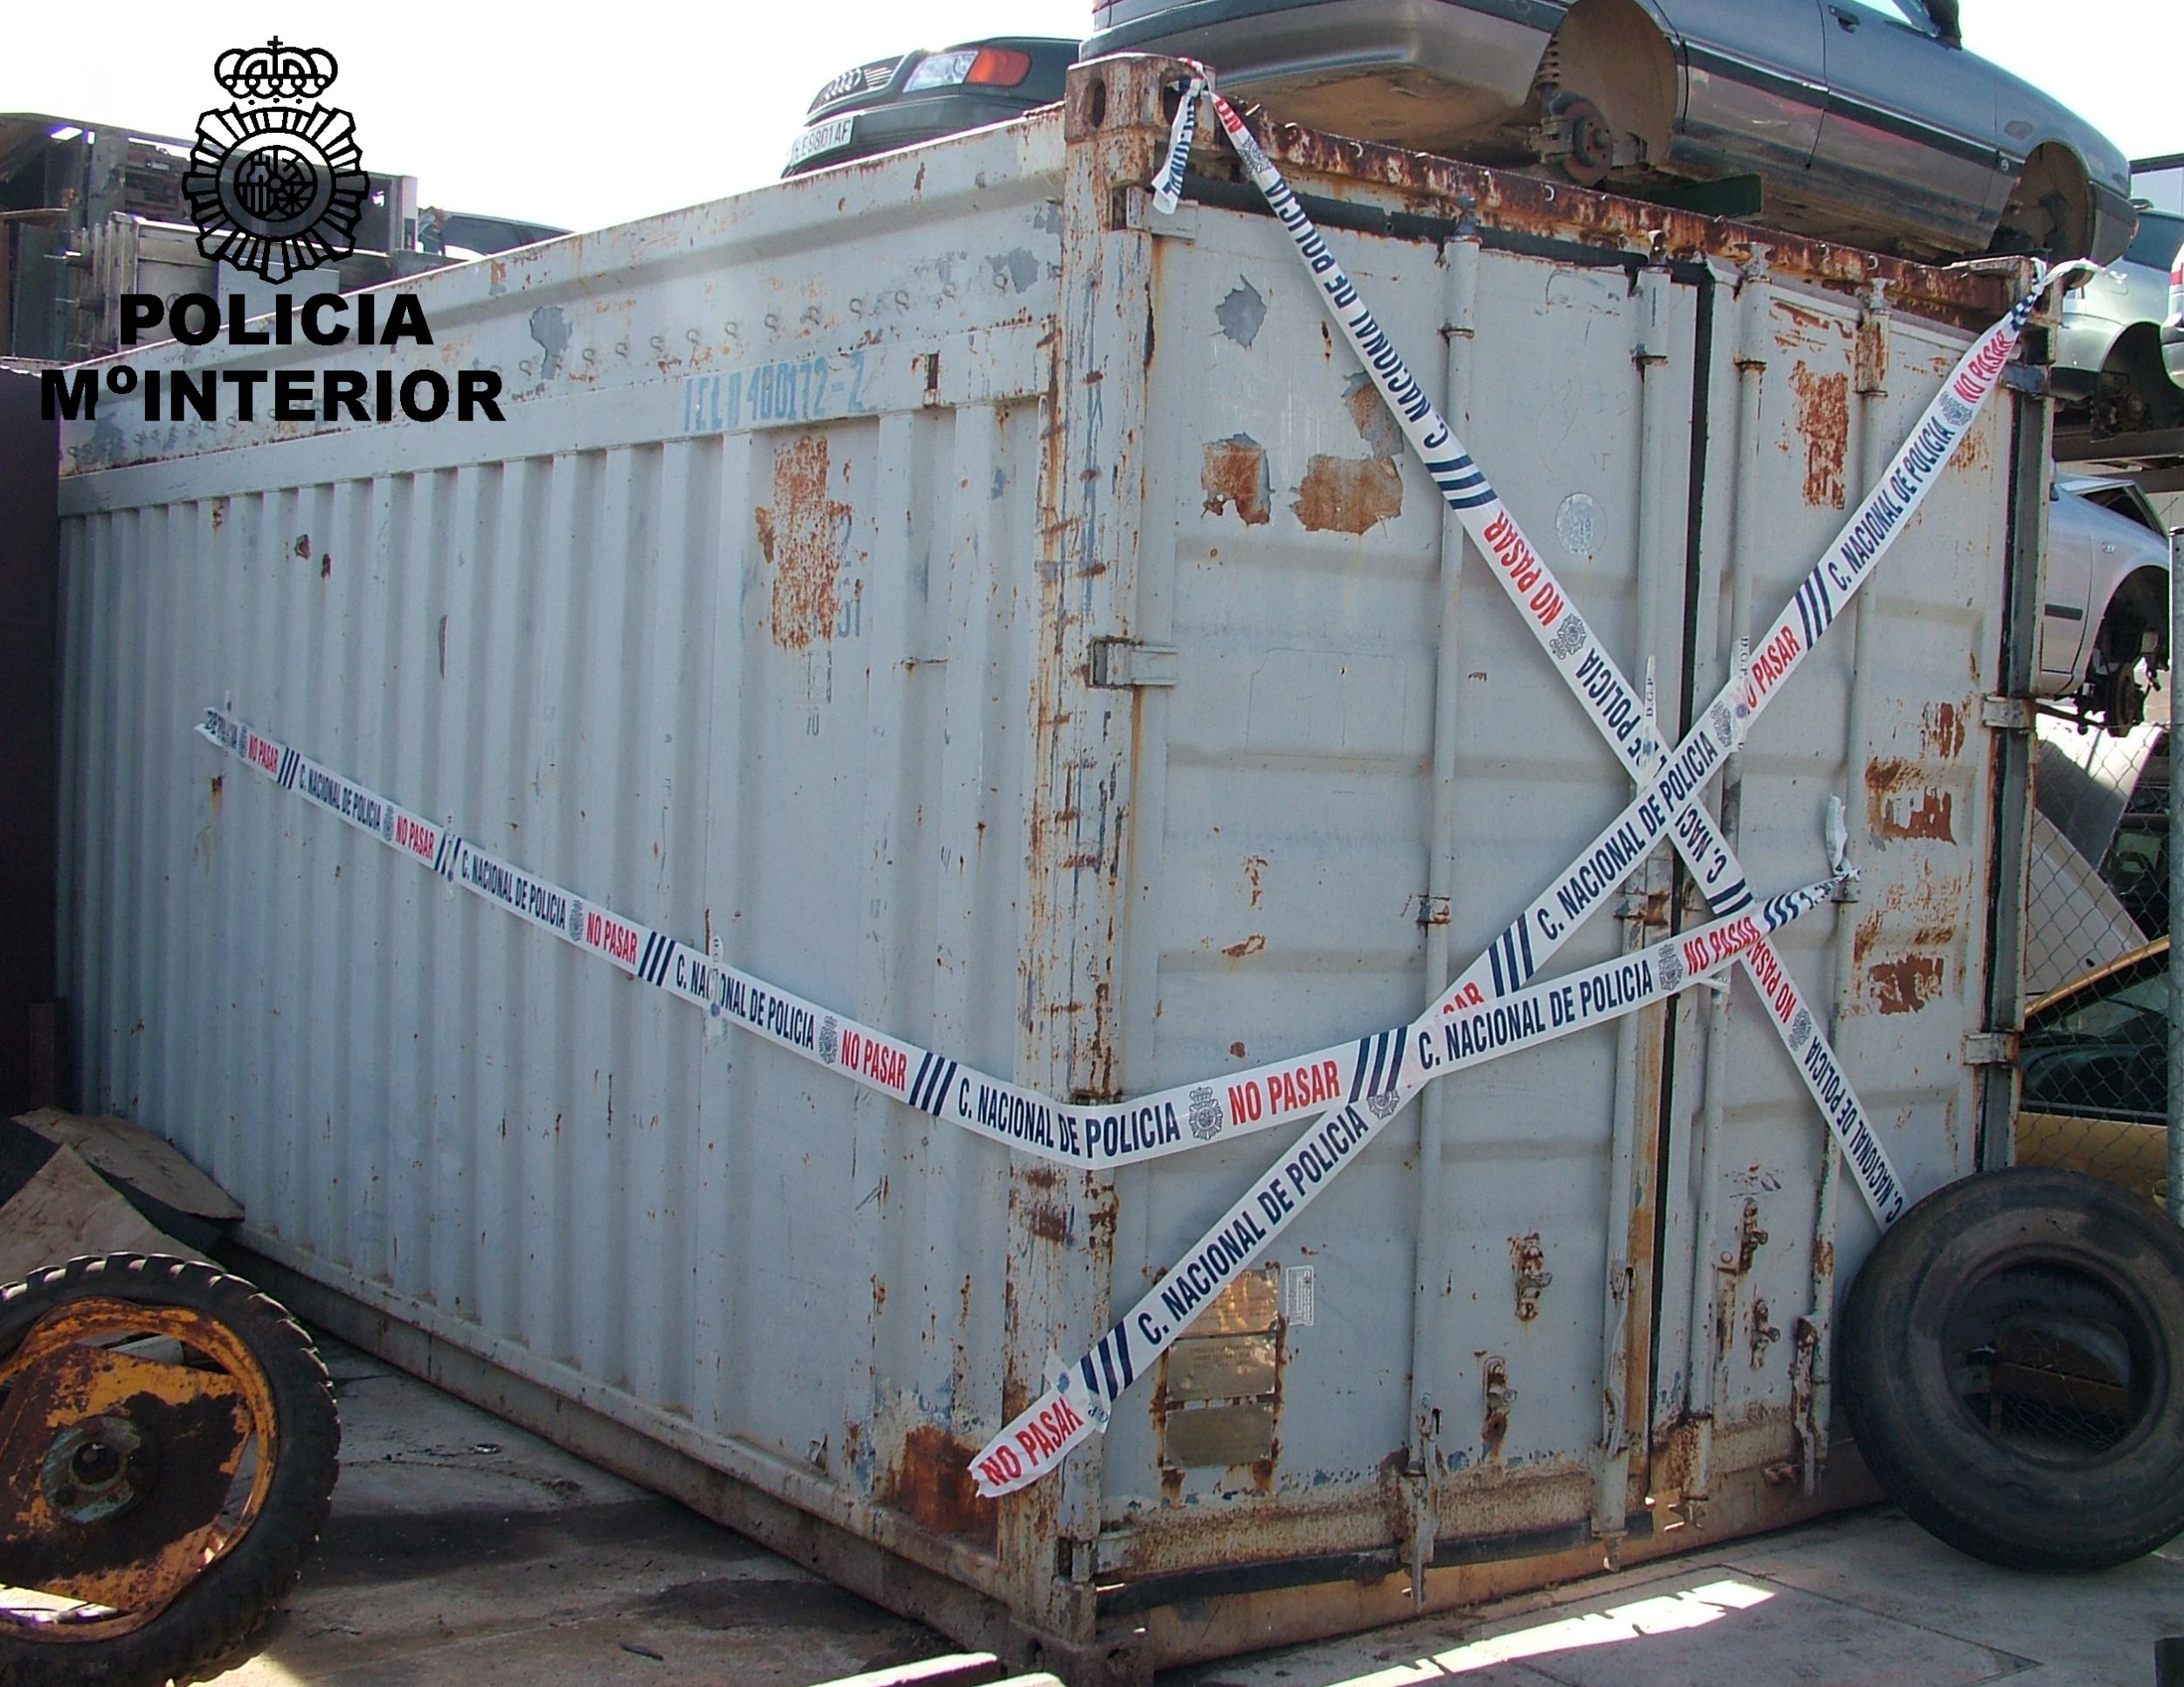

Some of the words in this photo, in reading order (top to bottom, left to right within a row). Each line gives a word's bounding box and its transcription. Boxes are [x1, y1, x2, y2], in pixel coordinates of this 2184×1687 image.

[1967, 329, 2015, 382] PASAR
[1952, 372, 1986, 404] NO
[1902, 415, 1956, 483] POLICIA
[1890, 467, 1918, 504] DE
[1483, 510, 1542, 593] PASAR
[1840, 488, 1904, 575] NACIONAL
[1530, 582, 1565, 626] NO
[1828, 562, 1852, 591] C.
[1751, 626, 1800, 695] PASAR
[1575, 647, 1641, 743] POLICIA
[395, 815, 408, 847] NO
[408, 821, 435, 861] PASAR
[1537, 908, 1565, 941] C.
[1556, 820, 1647, 921] NACIONAL
[1638, 793, 1667, 838] DE
[1658, 730, 1718, 813] POLICIA
[1706, 847, 1727, 884] C.
[461, 849, 470, 881] C.
[471, 854, 513, 903] NACIONAL
[515, 877, 528, 910] DE
[528, 883, 566, 930] POLICIA
[586, 911, 602, 947] NO
[603, 920, 638, 965] PASAR
[1683, 936, 1710, 977] NO
[1709, 916, 1764, 964] PASAR
[1745, 940, 1782, 998] PASA
[676, 953, 686, 989] C.
[749, 988, 766, 1027] DE
[767, 996, 814, 1051] POLICIA
[1418, 1031, 1441, 1070] C.
[1444, 997, 1546, 1062] NACIONAL
[1549, 985, 1576, 1027] DE
[1579, 959, 1654, 1018] POLICIA
[1774, 982, 1797, 1024] NO
[840, 1029, 860, 1071] NO
[862, 1039, 907, 1092] PASAR
[1804, 1035, 1847, 1115] POLICIA
[958, 1077, 972, 1119] C.
[977, 1084, 1054, 1149] NACIONAL
[1057, 1113, 1081, 1157] DE
[1085, 1102, 1181, 1159] POLICIA
[1227, 1081, 1262, 1126] NO
[1267, 1060, 1341, 1116] PASAR
[1835, 1097, 1858, 1137] DE
[1849, 1119, 1895, 1208] NACIONAL
[1137, 1312, 1170, 1345] C.
[1160, 1210, 1267, 1323] NACIONAL
[1256, 1178, 1295, 1226] DE
[1285, 1104, 1369, 1197] POLICIA
[978, 1445, 1022, 1487] NO
